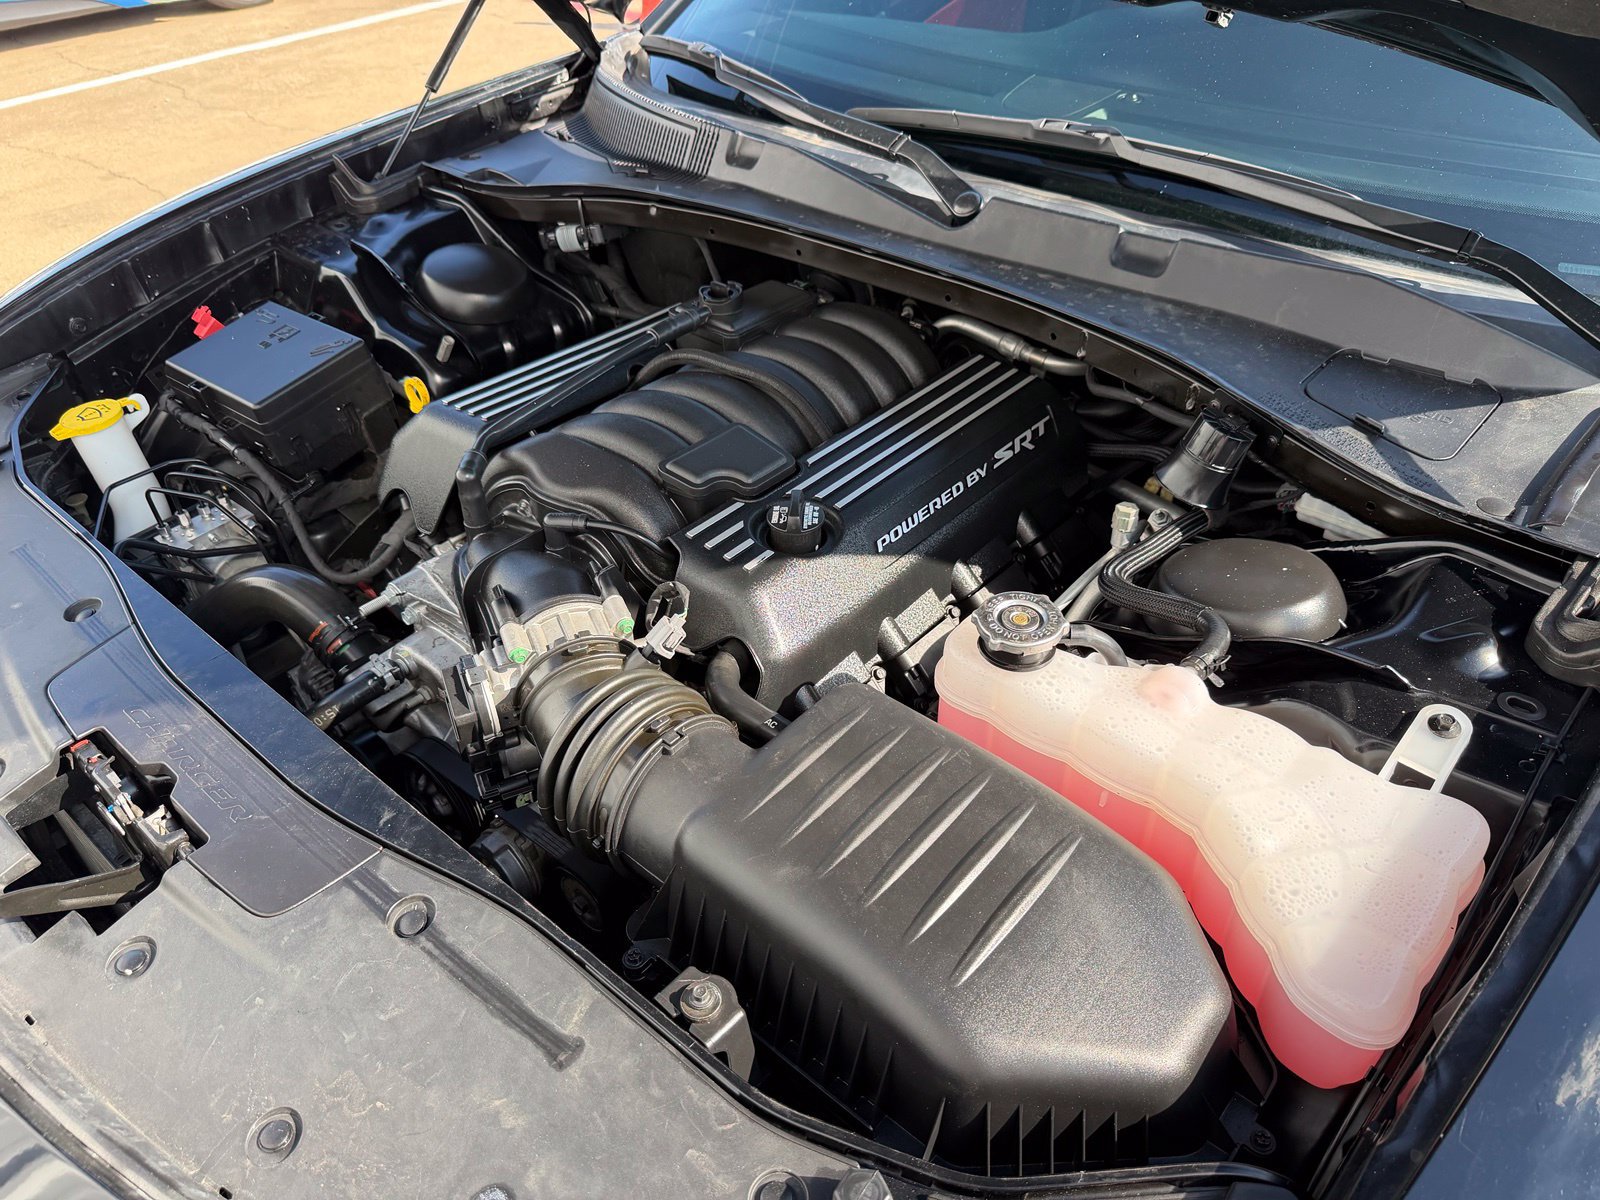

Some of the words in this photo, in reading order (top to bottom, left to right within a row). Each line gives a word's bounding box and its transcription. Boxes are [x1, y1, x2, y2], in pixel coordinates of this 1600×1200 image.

[876, 481, 965, 553] POWERED
[966, 462, 988, 488] BY
[993, 415, 1050, 470] SRT
[1009, 593, 1039, 603] TIGHT
[989, 623, 1003, 634] DO
[1003, 632, 1028, 640] NOT
[1030, 624, 1057, 640] OPEN
[1048, 610, 1059, 625] HOT
[763, 718, 778, 729] AC
[123, 707, 253, 824] CHARGER
